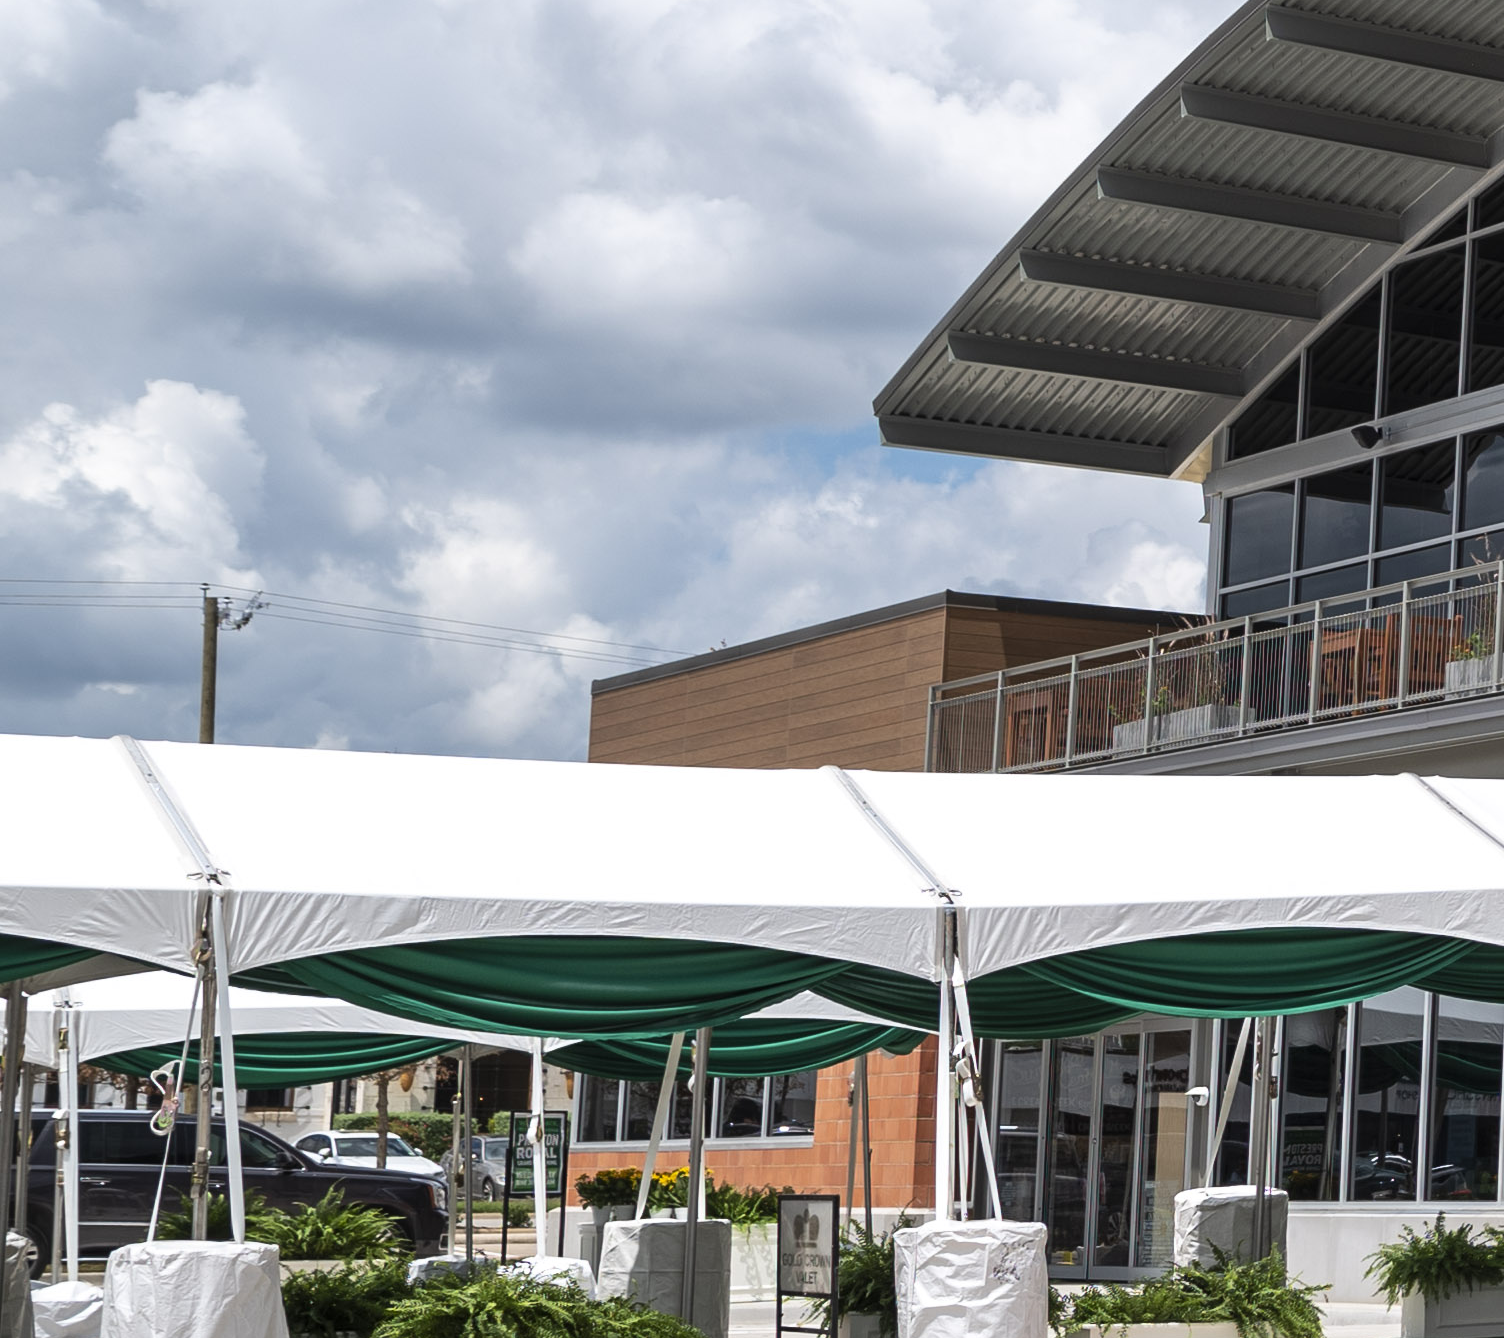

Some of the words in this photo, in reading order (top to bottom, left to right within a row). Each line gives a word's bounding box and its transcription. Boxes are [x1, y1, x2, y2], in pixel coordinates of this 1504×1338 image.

[516, 1147, 557, 1159] ROAL
[782, 1253, 804, 1267] GOLD
[804, 1254, 831, 1269] CROWN
[795, 1270, 818, 1284] VALET
